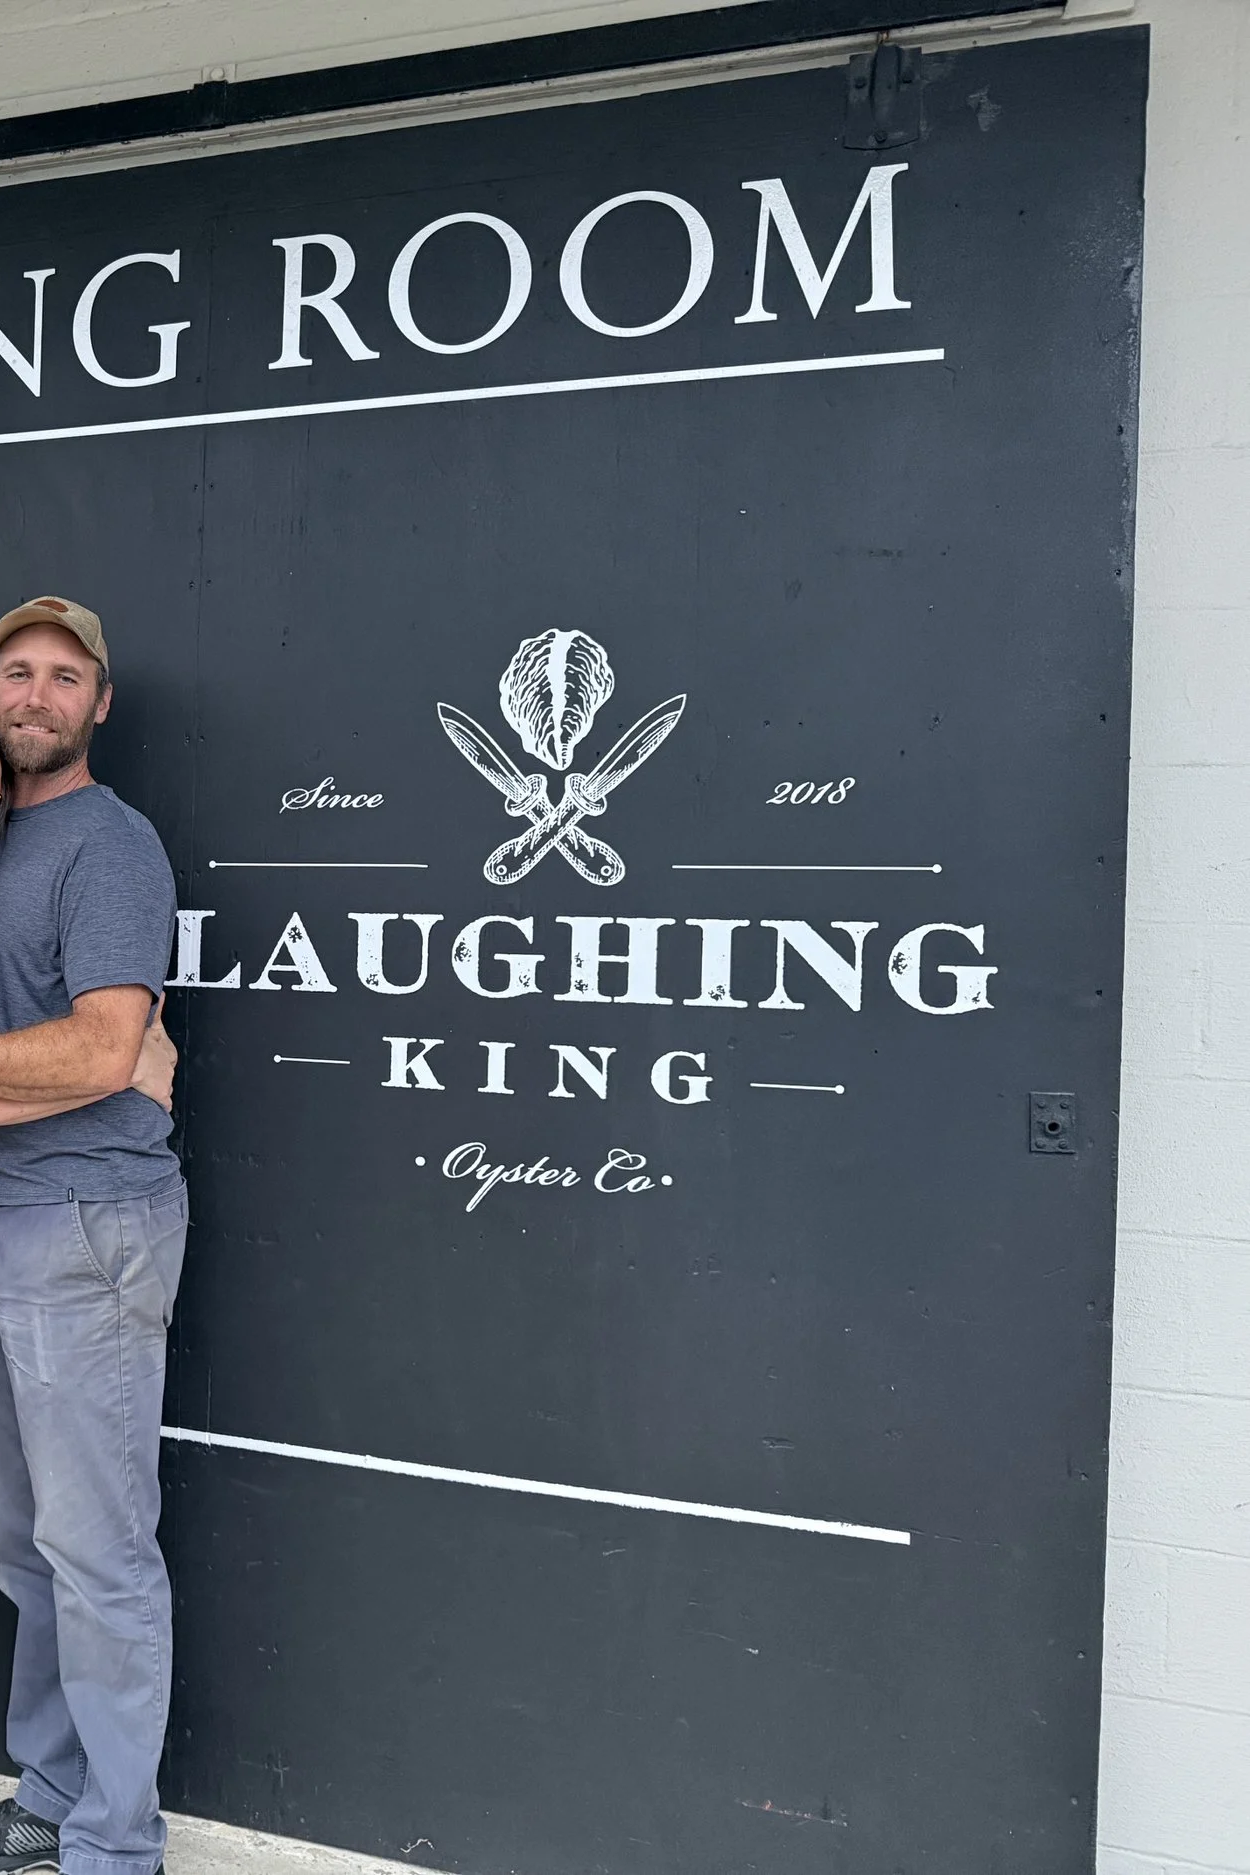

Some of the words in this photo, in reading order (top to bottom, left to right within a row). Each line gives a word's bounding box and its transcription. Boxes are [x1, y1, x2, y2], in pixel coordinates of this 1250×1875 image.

[268, 162, 912, 370] ROOM
[279, 776, 385, 814] Since
[765, 776, 856, 805] 2018
[163, 909, 999, 1015] LAUGHING
[380, 1036, 714, 1105] KING
[442, 1141, 582, 1213] Oyster
[593, 1148, 656, 1193] Co
